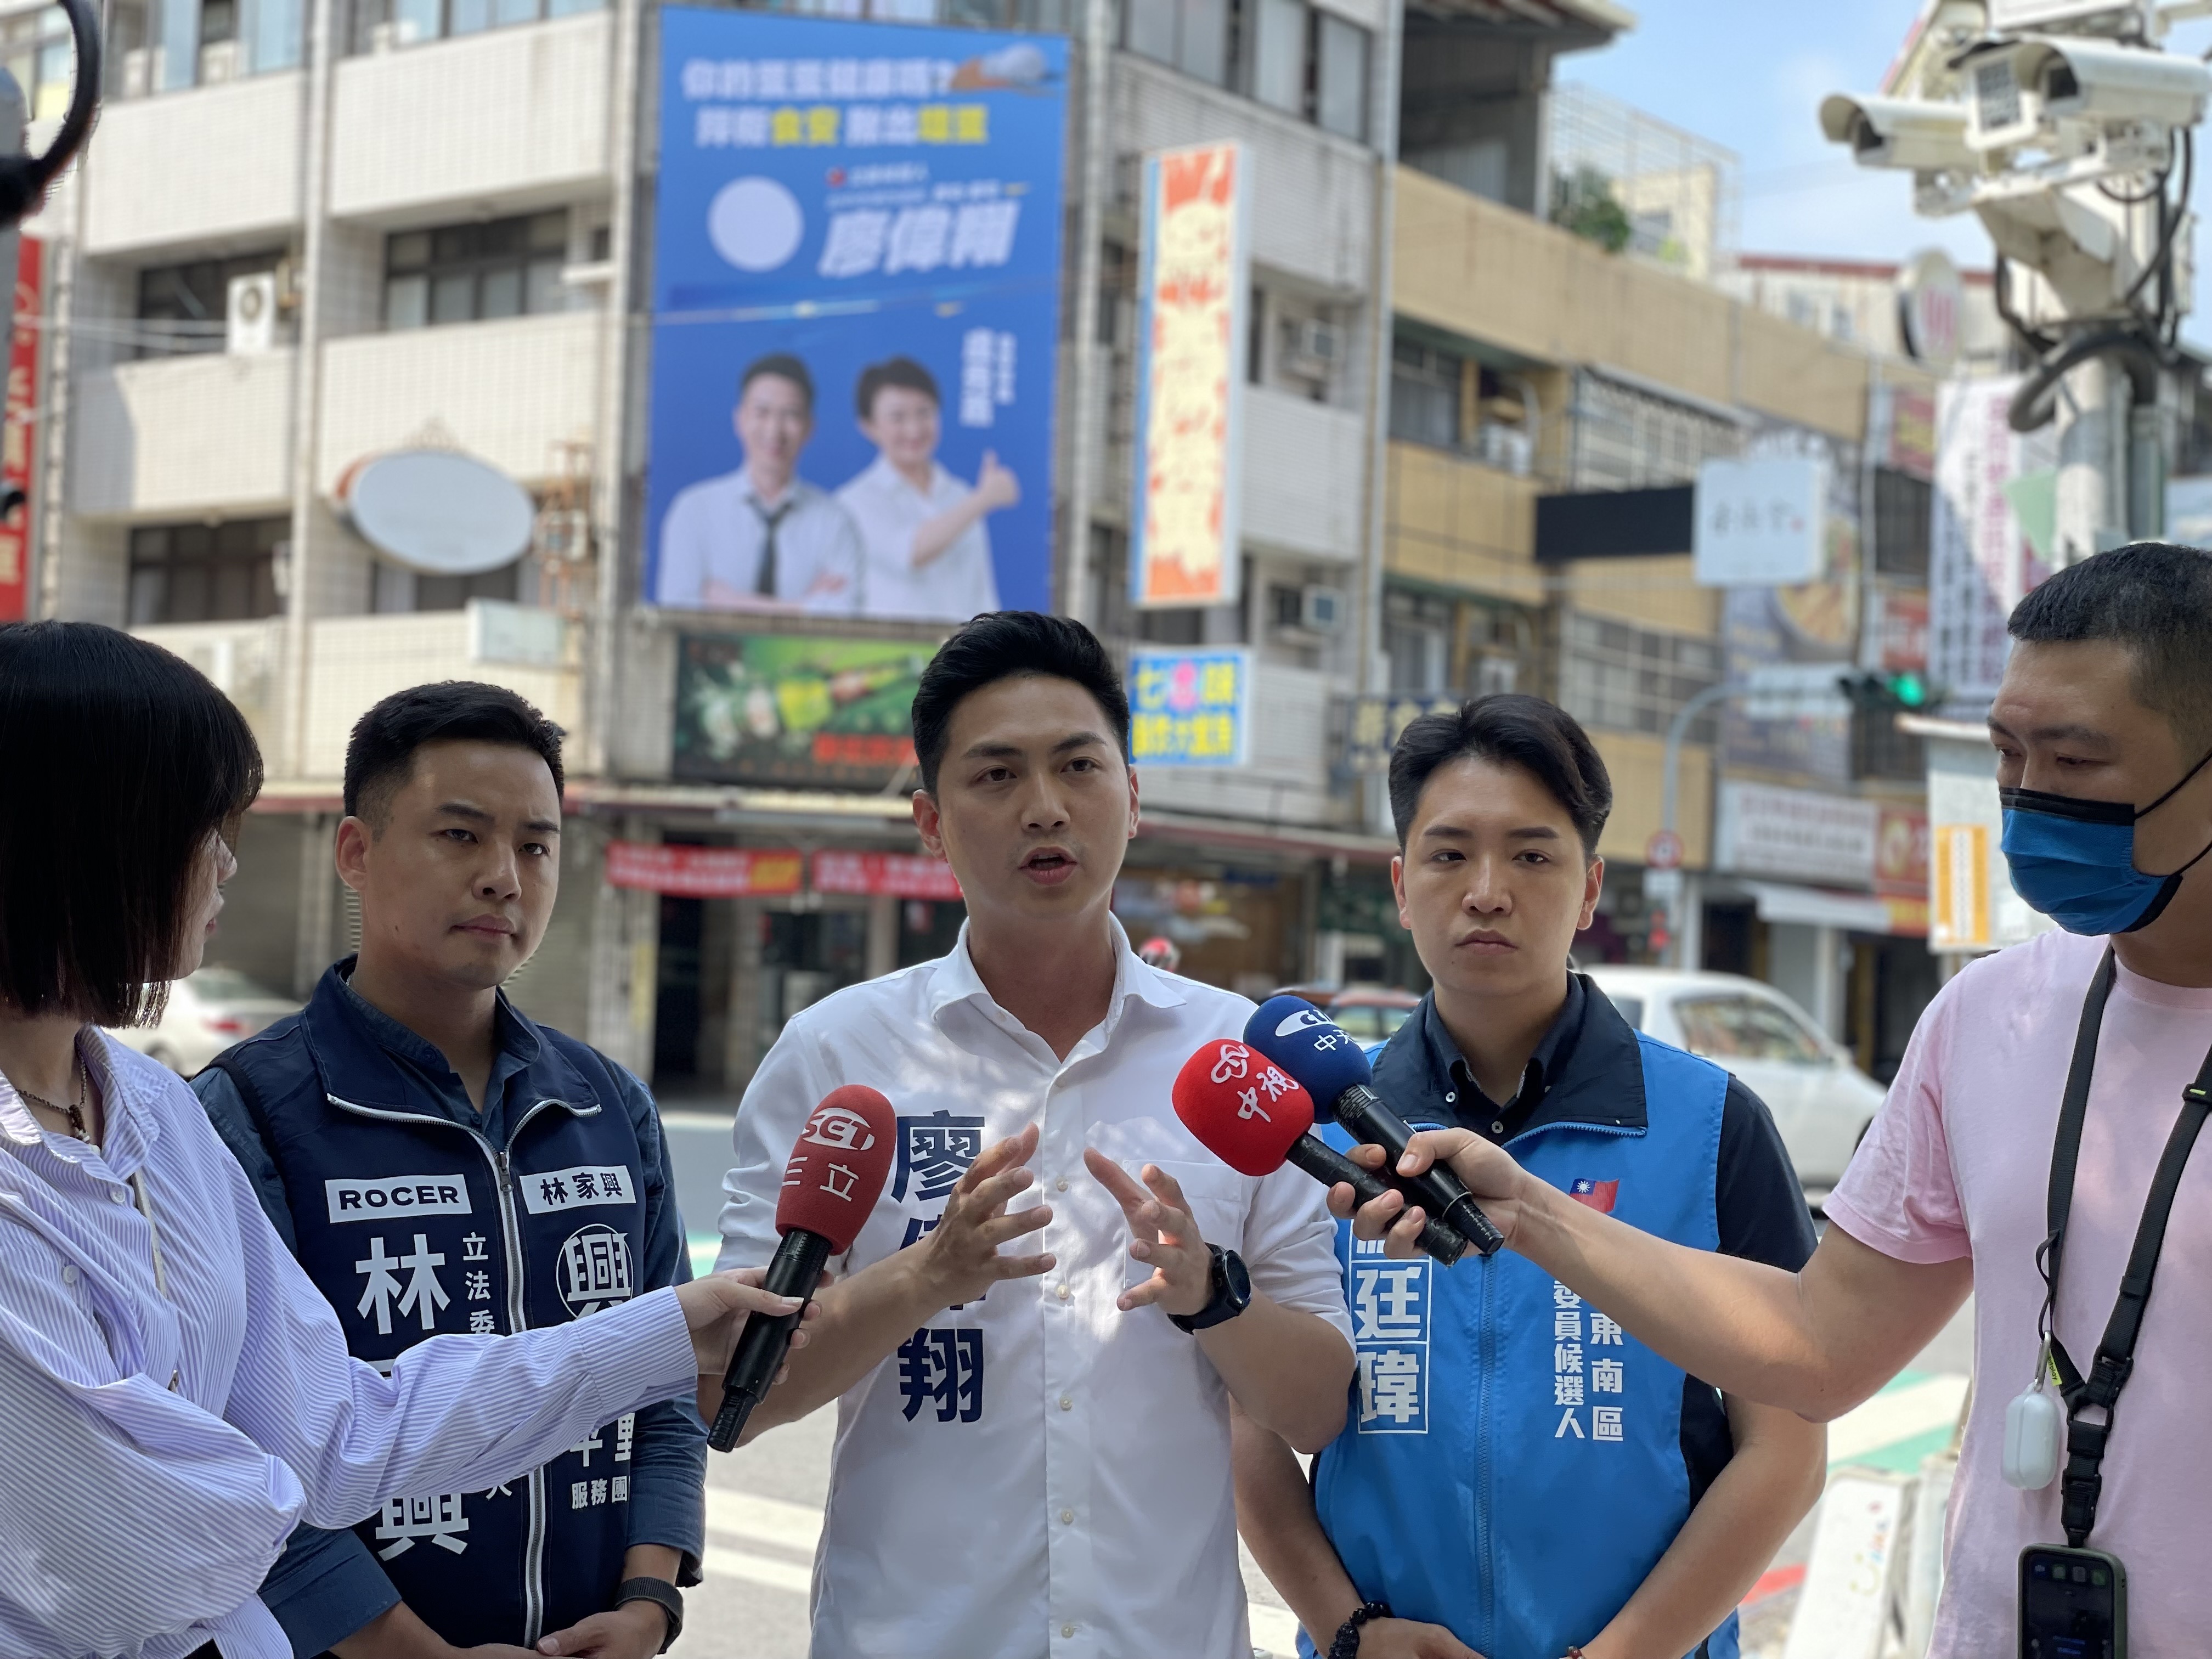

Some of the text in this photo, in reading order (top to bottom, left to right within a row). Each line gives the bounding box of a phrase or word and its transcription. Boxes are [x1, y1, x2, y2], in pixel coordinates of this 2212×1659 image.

[1237, 1066, 1299, 1122] 中視
[338, 1185, 460, 1210] ROCER
[540, 1172, 623, 1206] 林家興
[782, 1156, 860, 1202] 三立
[1353, 1240, 1422, 1424] 廷瑋
[572, 1475, 631, 1509] 服務團
